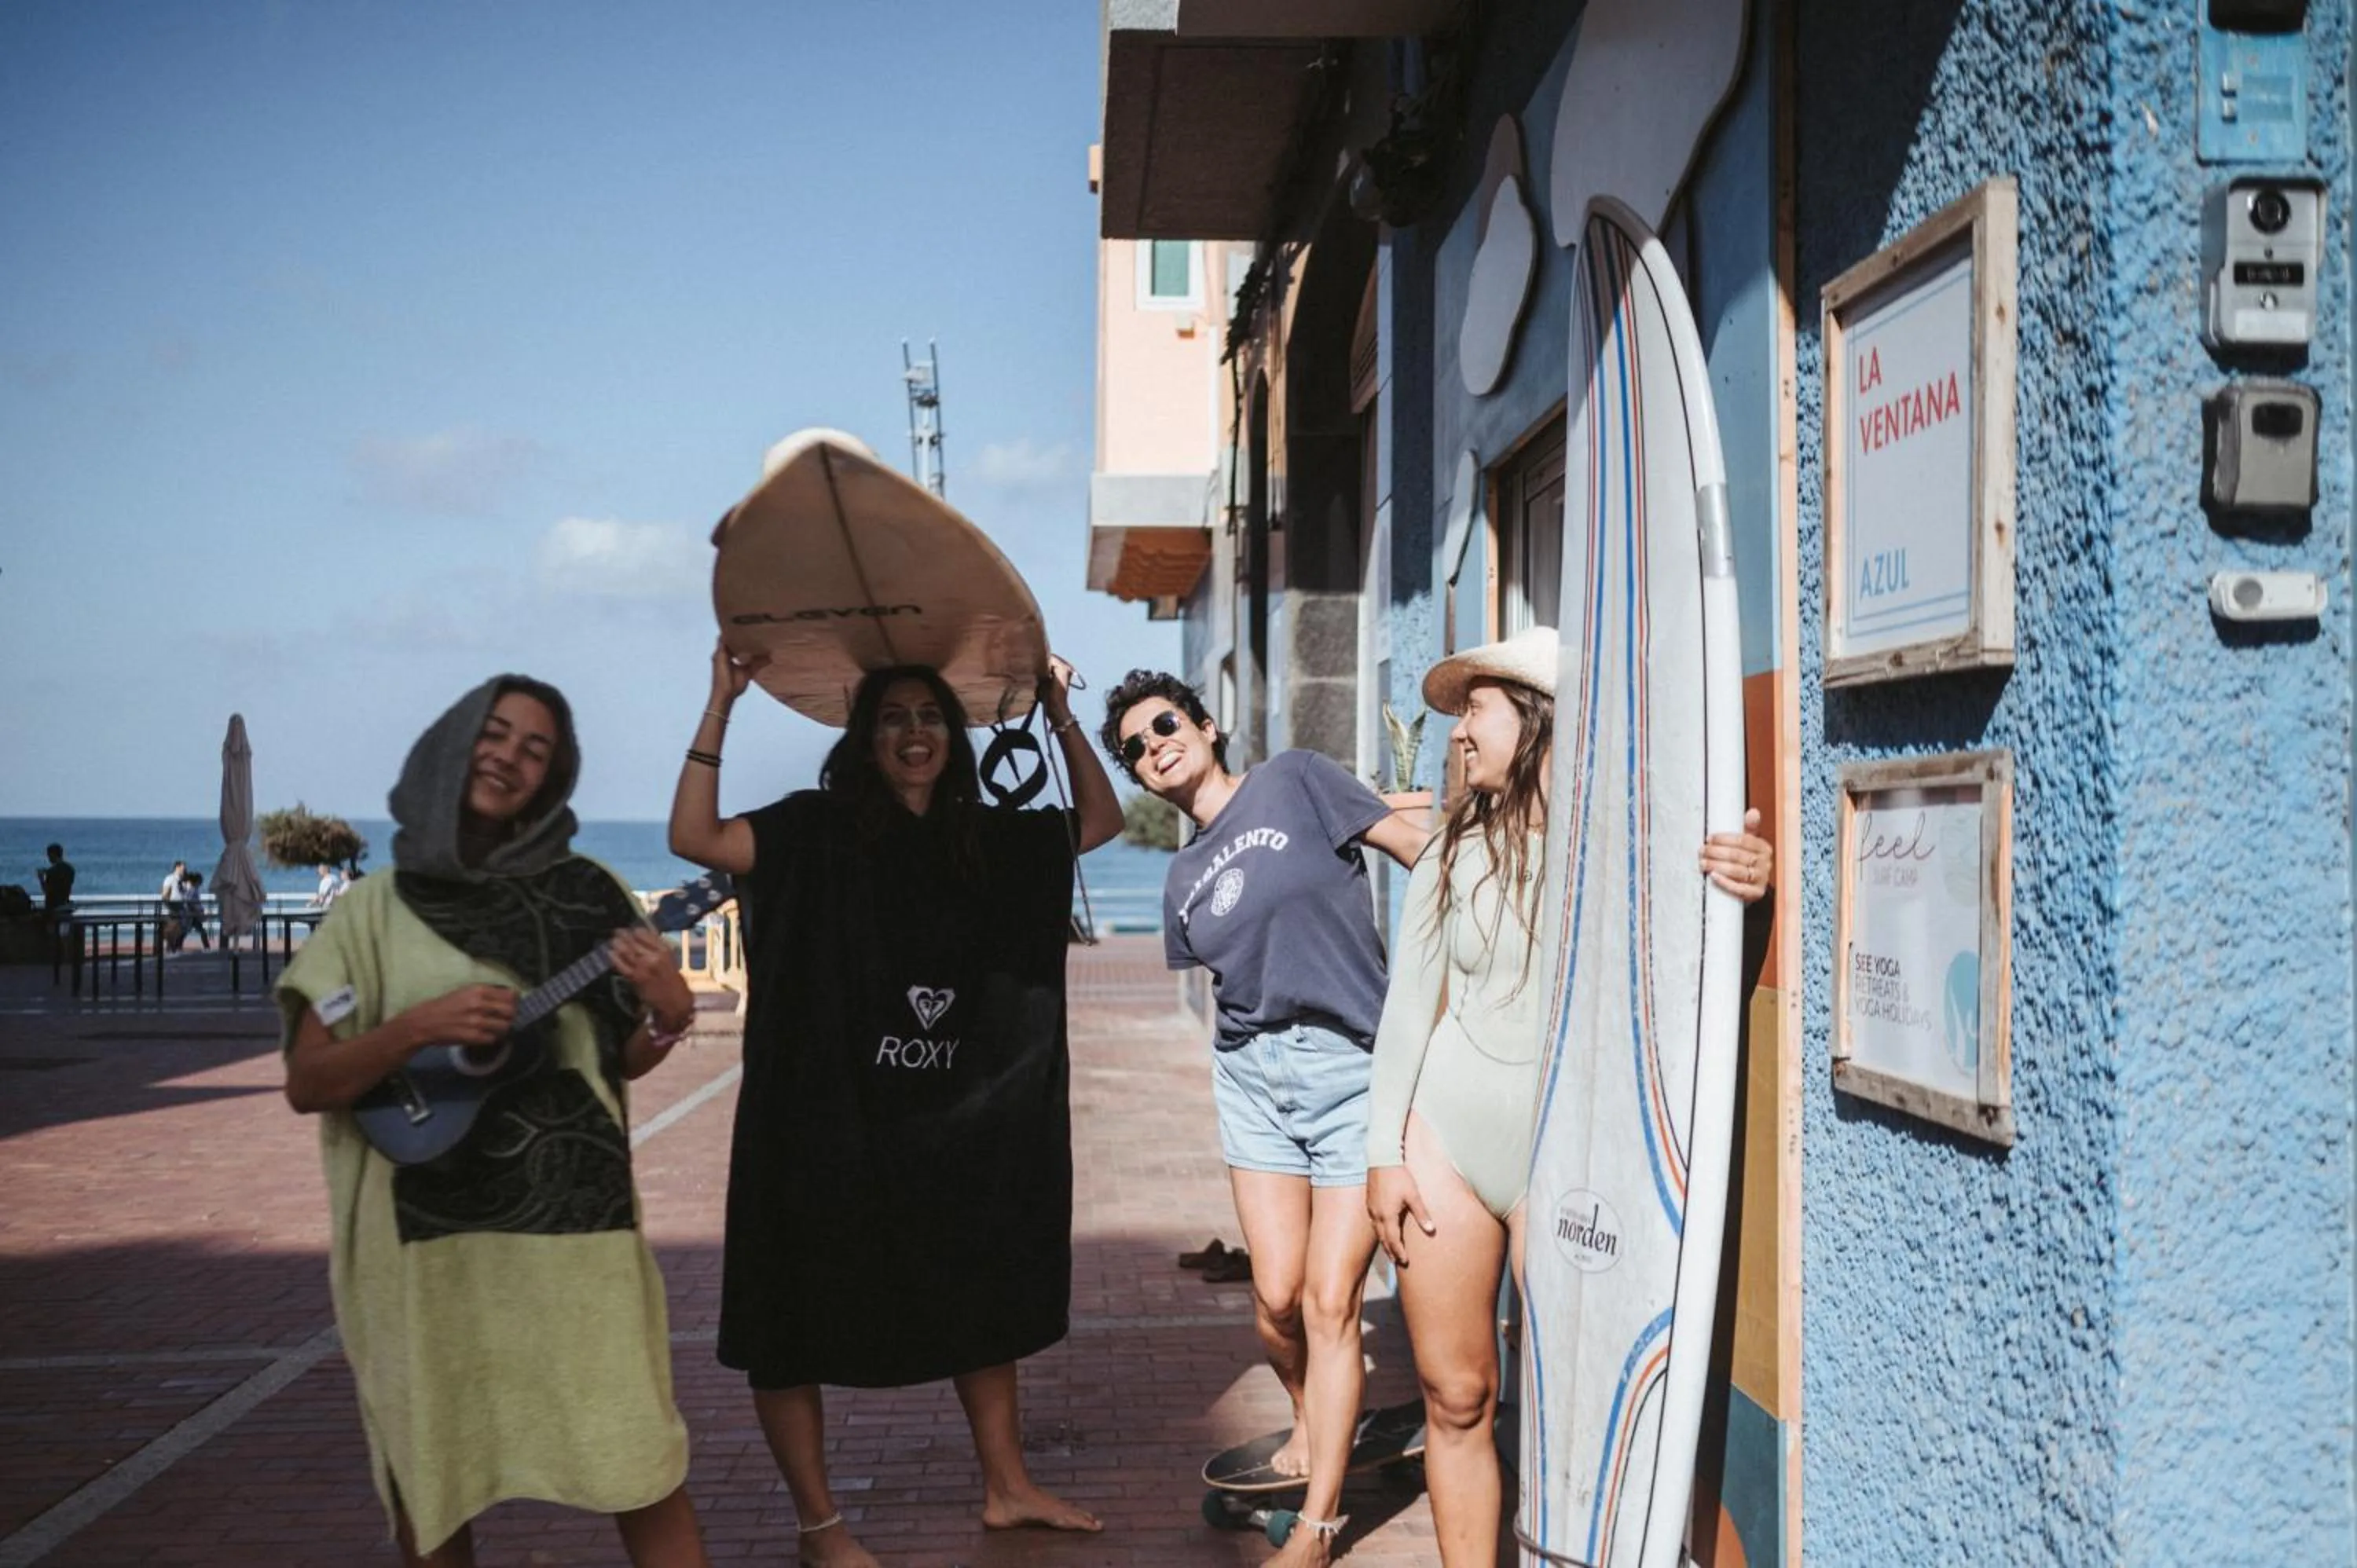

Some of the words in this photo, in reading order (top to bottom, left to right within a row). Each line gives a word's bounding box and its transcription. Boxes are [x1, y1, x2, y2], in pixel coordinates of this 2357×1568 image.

[1860, 346, 1882, 394] LA
[1860, 371, 1960, 456] VENTANA
[1859, 546, 1910, 603] AZUL
[1855, 952, 1872, 973] SEE
[1875, 956, 1901, 976] YOGA
[1855, 996, 1881, 1019] YOGA
[875, 1035, 960, 1069] ROXY
[1557, 1203, 1617, 1256] norden
